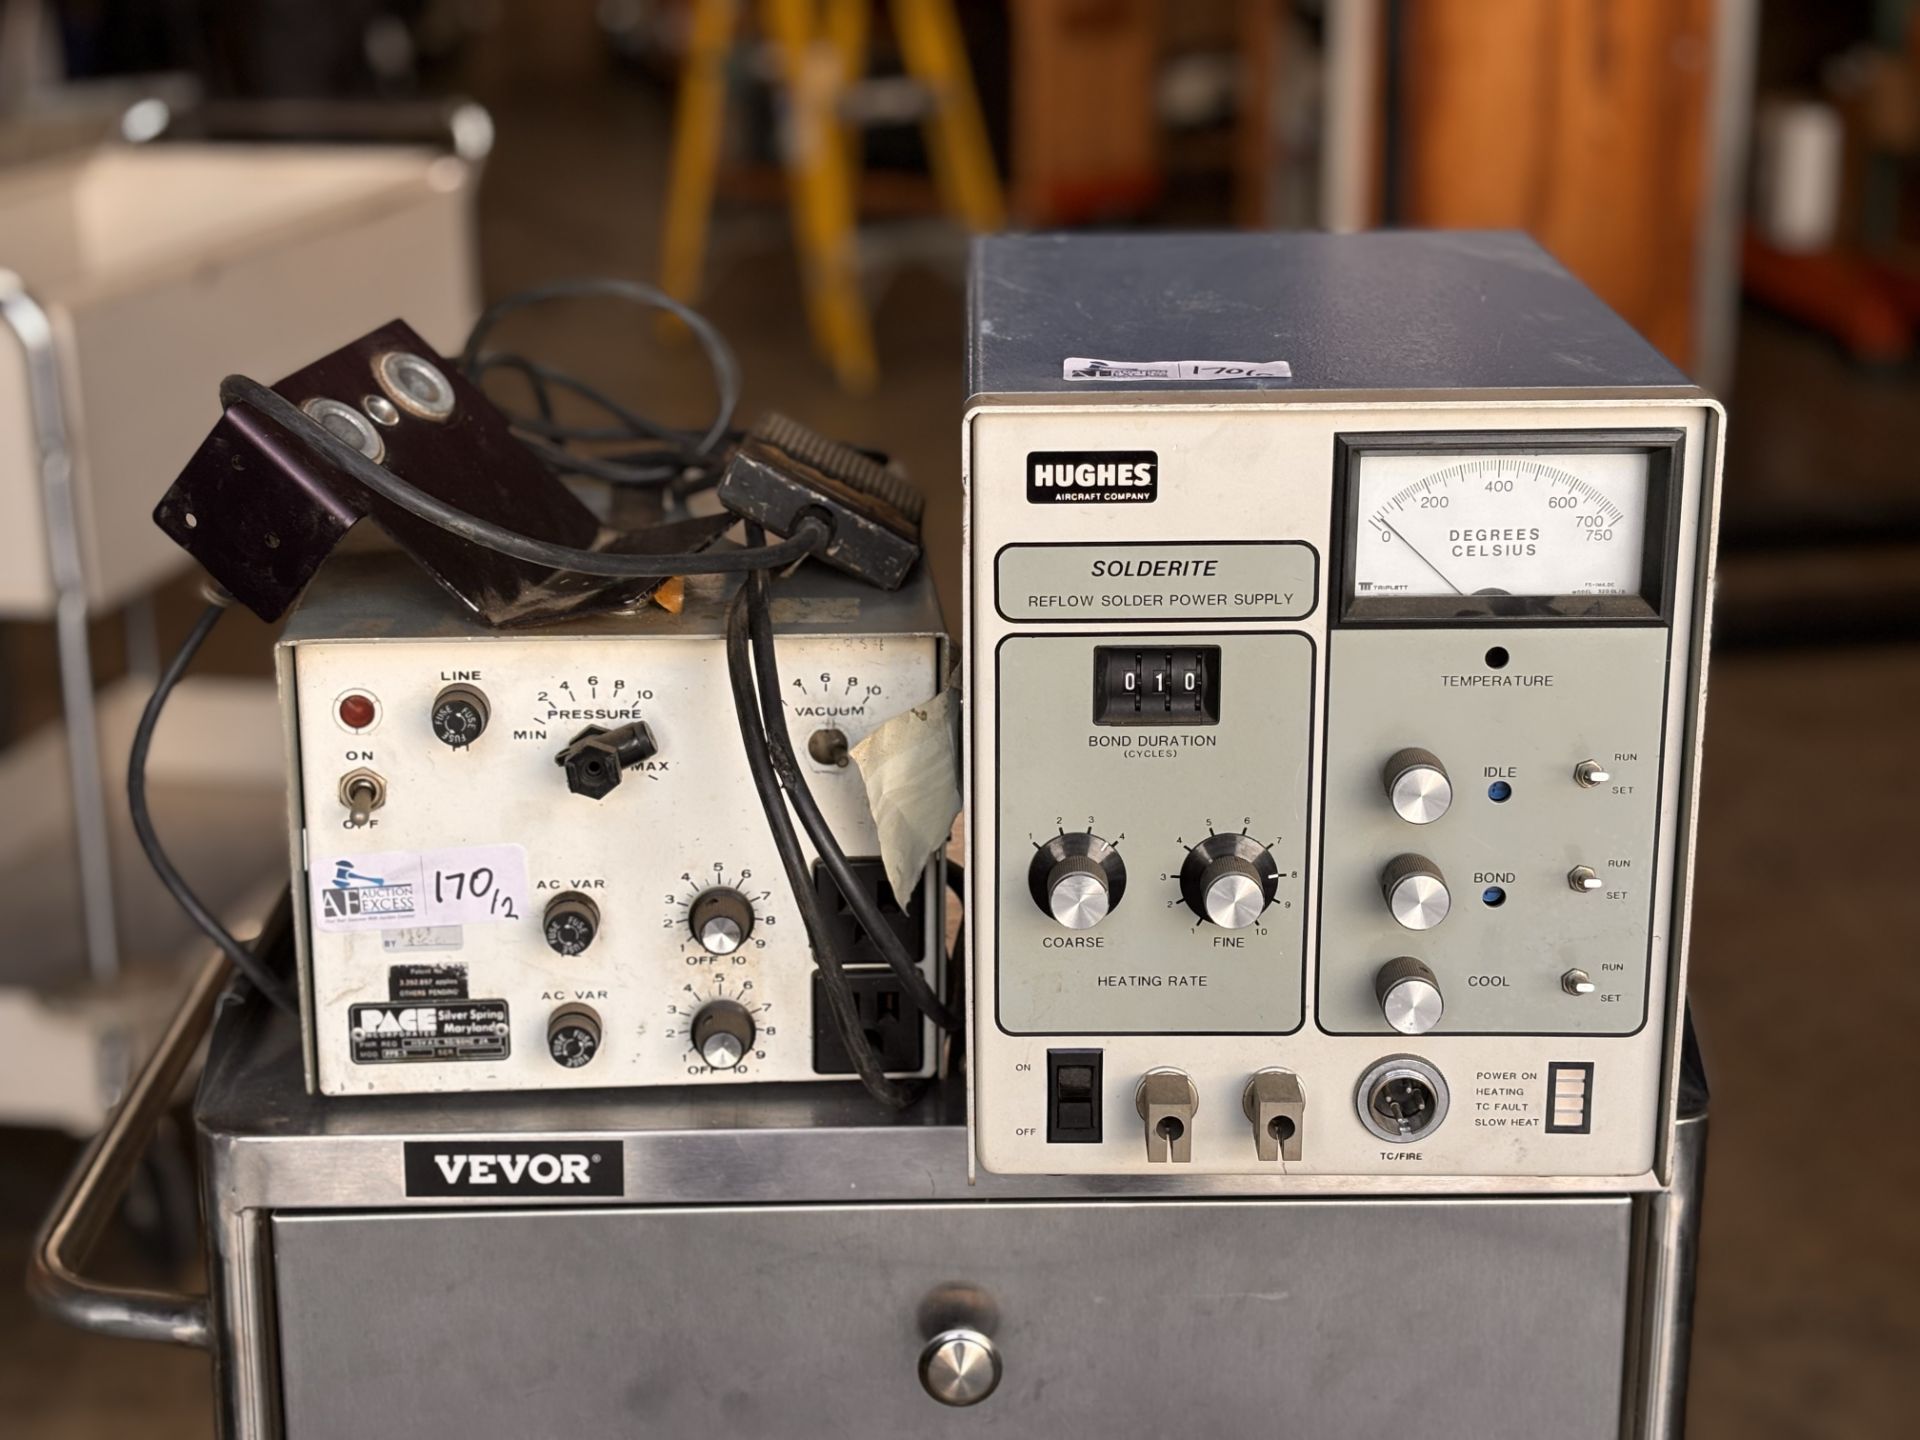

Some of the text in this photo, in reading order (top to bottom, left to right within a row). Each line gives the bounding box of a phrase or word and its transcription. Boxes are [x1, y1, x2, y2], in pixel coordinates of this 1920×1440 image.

[1035, 463, 1151, 487] HUGHES
[1484, 480, 1513, 493] 400
[1055, 492, 1150, 501] AIRCRAFT COMPANY
[1420, 496, 1449, 509] 200
[1548, 496, 1577, 509] 600
[1575, 516, 1603, 528] 700
[1381, 530, 1391, 543] 0
[1449, 528, 1541, 542] DEGREES
[1585, 529, 1613, 542] 750
[1451, 544, 1537, 557] CELSIUS
[1091, 560, 1218, 577] SOLDERITE
[1028, 593, 1294, 608] REFLOW SOLDER POWER SUPPLY
[440, 670, 482, 681] LINE
[793, 673, 881, 695] 4 6 8 10
[1441, 676, 1553, 687] TEMPERATURE
[537, 676, 654, 702] 2 4 6 8 10
[434, 705, 452, 725] FUSE
[547, 709, 642, 720] PRESSURE
[795, 706, 864, 717] VACUUM
[461, 707, 477, 729] FUSE
[441, 731, 466, 742] FUSE
[513, 730, 547, 741] MIN
[1088, 735, 1217, 747] BOND DURATION
[345, 751, 374, 761] ON
[1124, 750, 1178, 759] (CYCLES)
[1614, 753, 1638, 761] RUN
[630, 761, 670, 771] MAX
[1484, 767, 1517, 778] IDLE
[1612, 786, 1634, 794] SET
[342, 819, 379, 830] OF
[1088, 816, 1094, 824] 3
[1176, 836, 1182, 844] 4
[1206, 818, 1213, 826] 5
[1244, 817, 1250, 825] 6
[713, 863, 723, 871] 5
[1608, 860, 1631, 868] RUN
[681, 873, 690, 881] 4
[742, 870, 751, 878] 6
[1473, 872, 1516, 883] BOND
[536, 879, 606, 890] AC VAR
[361, 887, 413, 897] AUCTION
[761, 892, 771, 900] 7
[1606, 891, 1628, 900] SET
[362, 898, 415, 911] EXCESS
[665, 895, 675, 904] 3
[663, 919, 673, 928] 2
[765, 916, 776, 925] 8
[756, 939, 765, 948] 9
[1042, 937, 1105, 948] COARSE
[1213, 937, 1245, 948] FINE
[686, 956, 747, 965] OFF 10
[1602, 963, 1624, 971] RUN
[714, 973, 725, 982] 5
[1098, 976, 1208, 987] HEATING RATE
[1468, 976, 1510, 987] COOL
[683, 984, 692, 992] 4
[743, 981, 753, 990] 6
[541, 990, 609, 1000] AC VAR
[1601, 994, 1622, 1002] SET
[667, 1005, 677, 1014] 3
[761, 1003, 771, 1012] 7
[438, 1008, 504, 1021] Silver Spring
[360, 1008, 437, 1032] PACE
[444, 1022, 497, 1034] Maryland
[766, 1027, 776, 1035] 8
[666, 1030, 675, 1038] 2
[755, 1050, 766, 1059] 9
[732, 1065, 748, 1074] 10
[1477, 1072, 1537, 1080] POWER ON
[1476, 1088, 1524, 1096] HEATING
[1475, 1103, 1529, 1111] TC FAULT
[1475, 1118, 1540, 1127] SLOW HEAT
[1015, 1128, 1037, 1136] OFF
[1380, 1152, 1423, 1161] TC/FIRE
[434, 1154, 591, 1184] VEVOR
